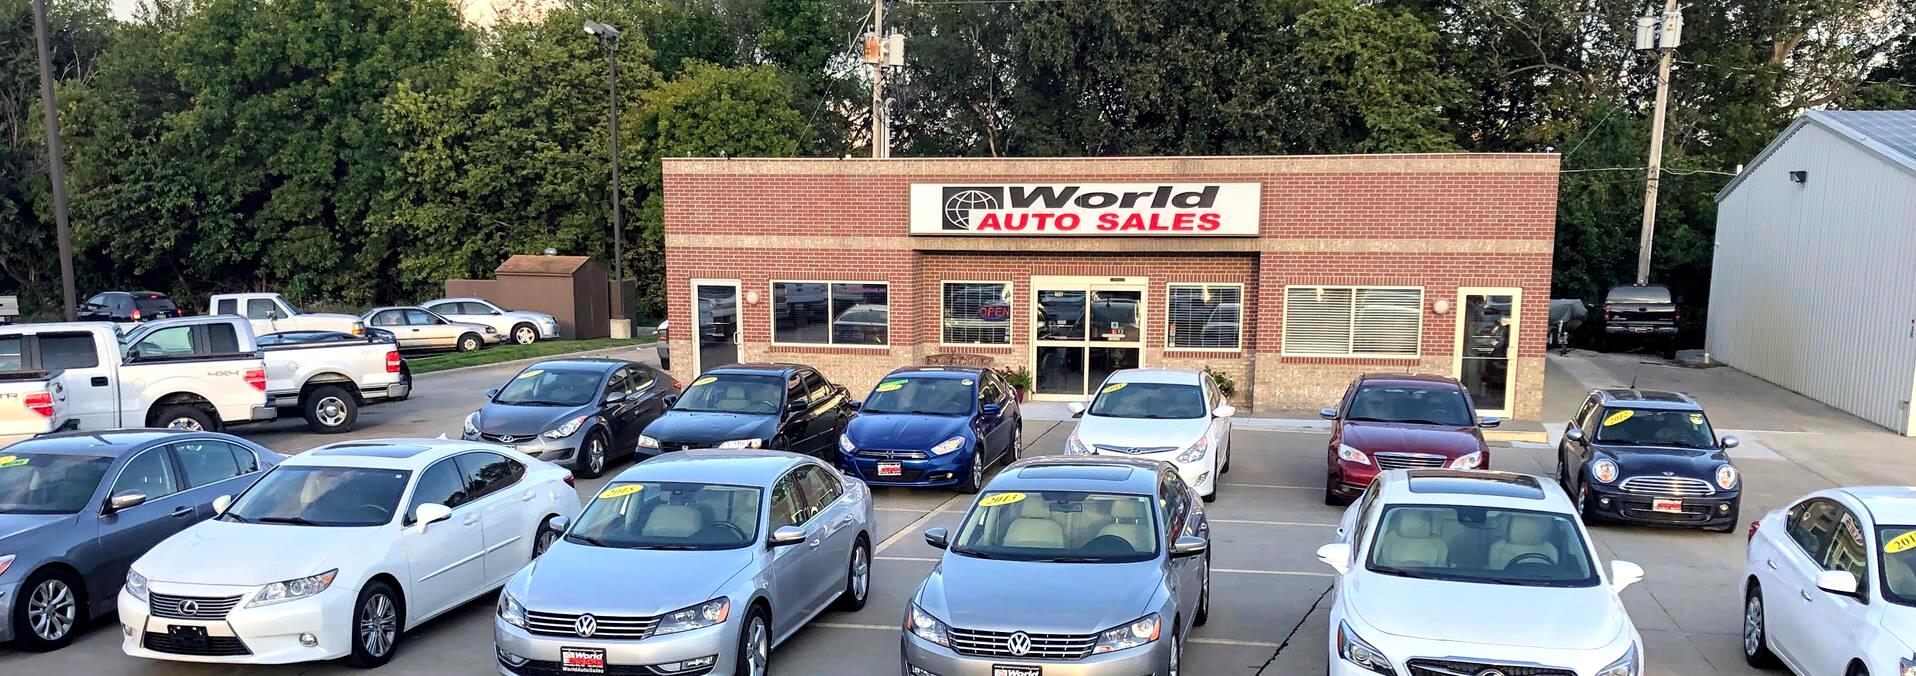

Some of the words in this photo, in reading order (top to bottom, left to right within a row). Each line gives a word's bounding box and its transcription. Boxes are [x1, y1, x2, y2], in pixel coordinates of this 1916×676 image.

[1008, 185, 1221, 209] World
[976, 212, 1081, 231] AUTO
[1096, 213, 1222, 231] SALES
[980, 307, 1009, 317] OPEN
[1894, 532, 1916, 550] 201
[575, 652, 603, 660] World
